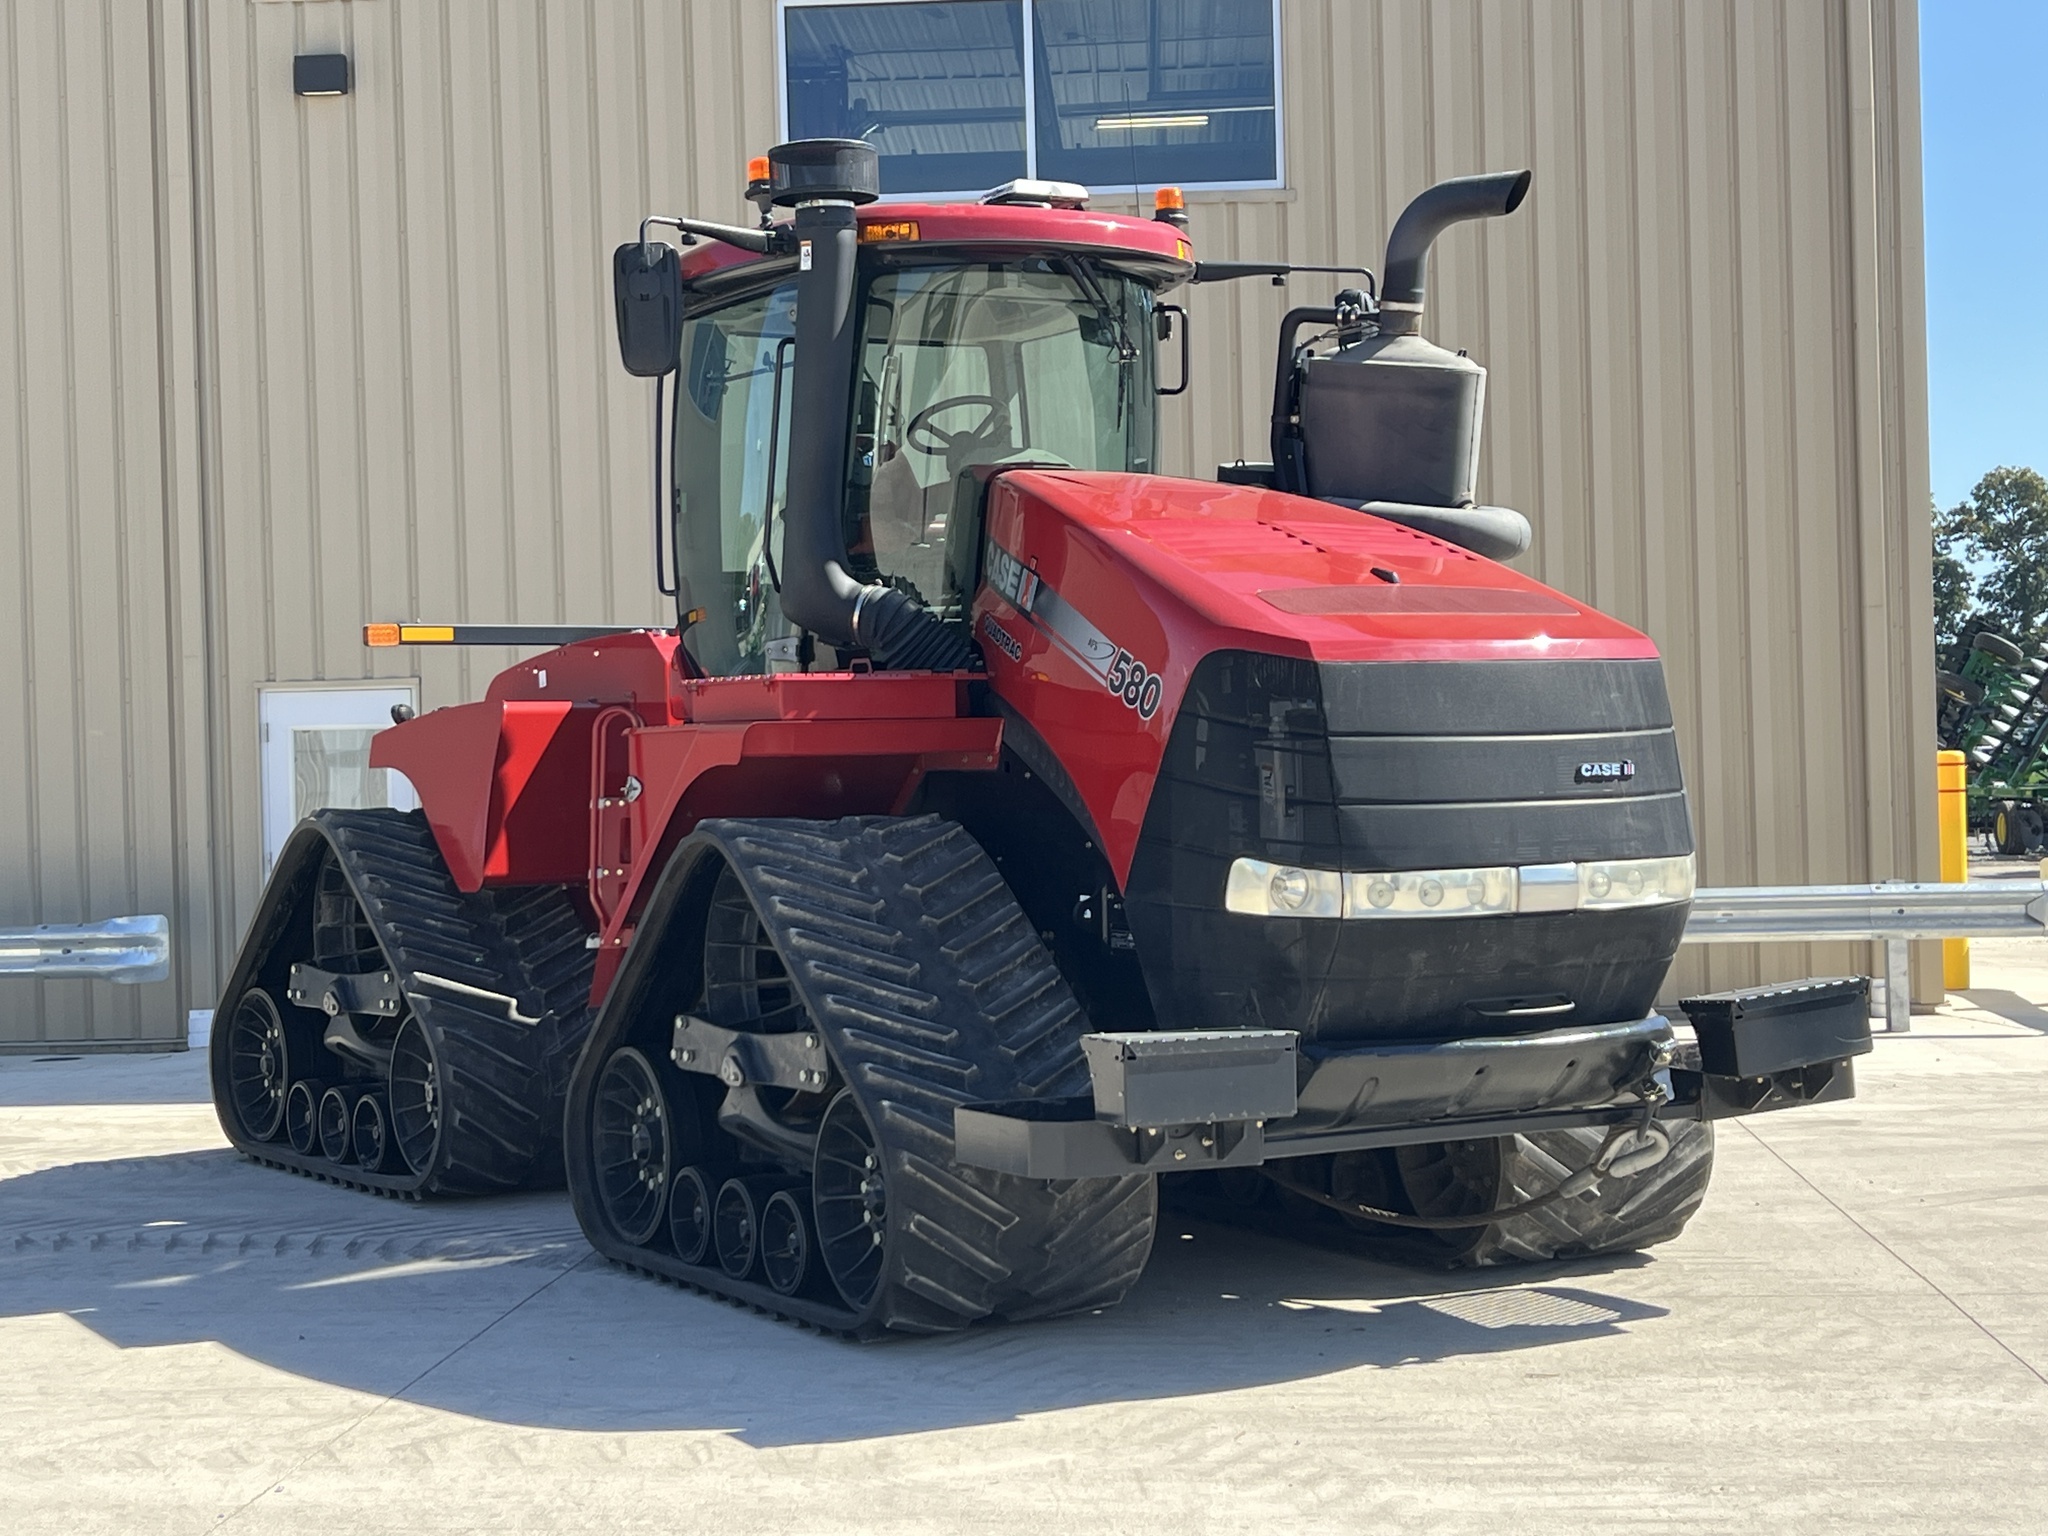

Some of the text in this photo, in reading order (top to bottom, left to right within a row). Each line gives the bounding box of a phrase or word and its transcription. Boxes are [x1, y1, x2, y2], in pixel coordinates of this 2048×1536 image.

[986, 540, 1022, 600] CASE
[1107, 647, 1163, 720] 580
[1581, 763, 1621, 777] CASE
